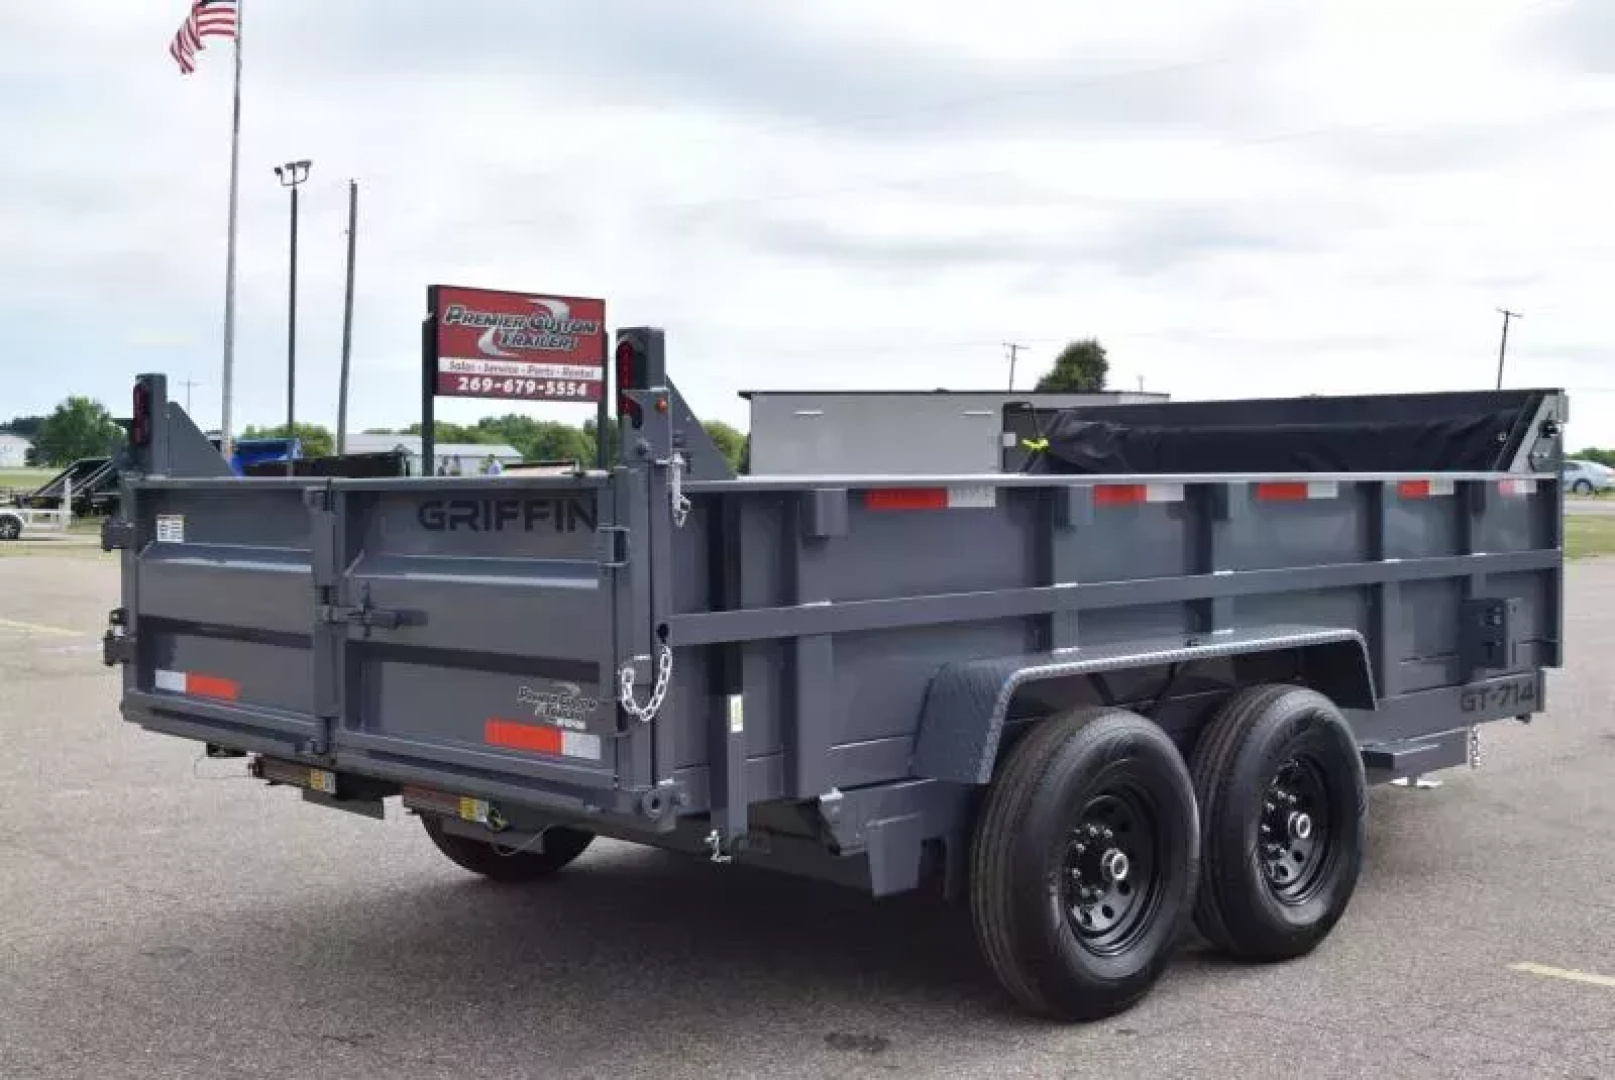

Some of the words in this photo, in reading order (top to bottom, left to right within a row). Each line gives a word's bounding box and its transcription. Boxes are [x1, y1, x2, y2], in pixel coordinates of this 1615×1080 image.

[443, 305, 528, 329] PREMIER
[457, 376, 588, 397] 269-679-5554
[418, 499, 598, 533] GRIFFIN
[1461, 682, 1535, 712] GT-714
